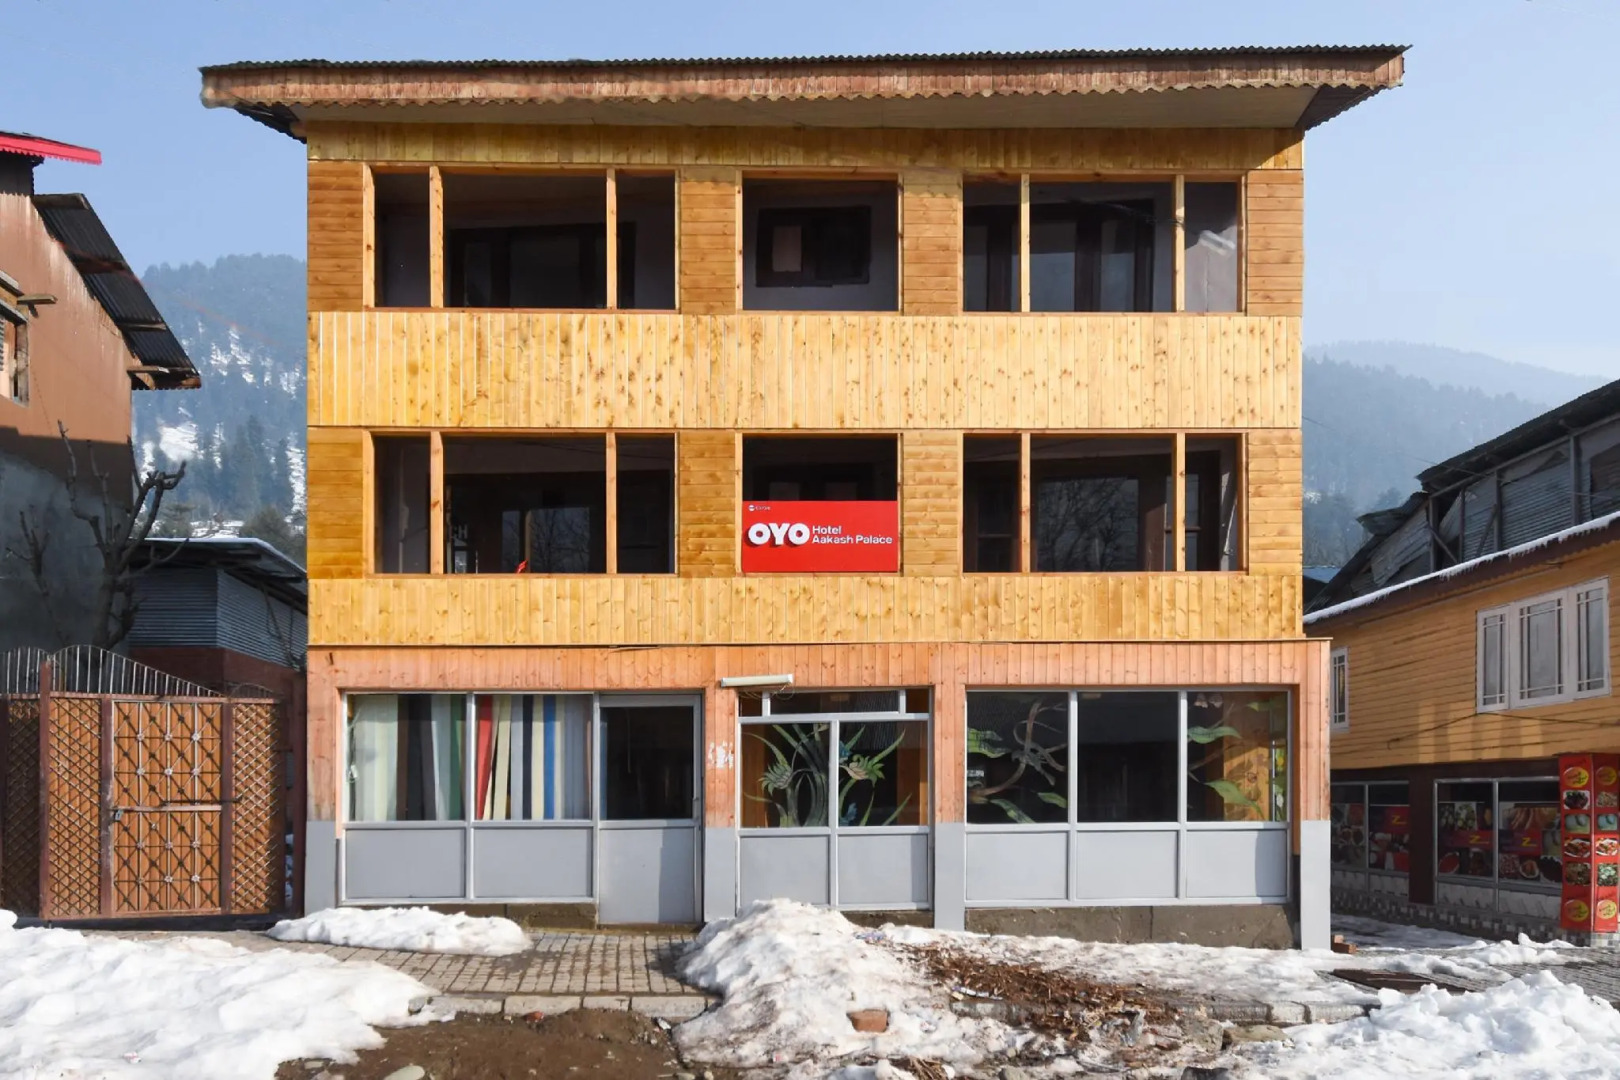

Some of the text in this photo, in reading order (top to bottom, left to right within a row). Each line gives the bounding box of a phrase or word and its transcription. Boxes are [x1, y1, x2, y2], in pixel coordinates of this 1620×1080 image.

[748, 522, 810, 545] OYO
[812, 525, 842, 535] Hotel
[812, 535, 893, 544] Aakash Palace
